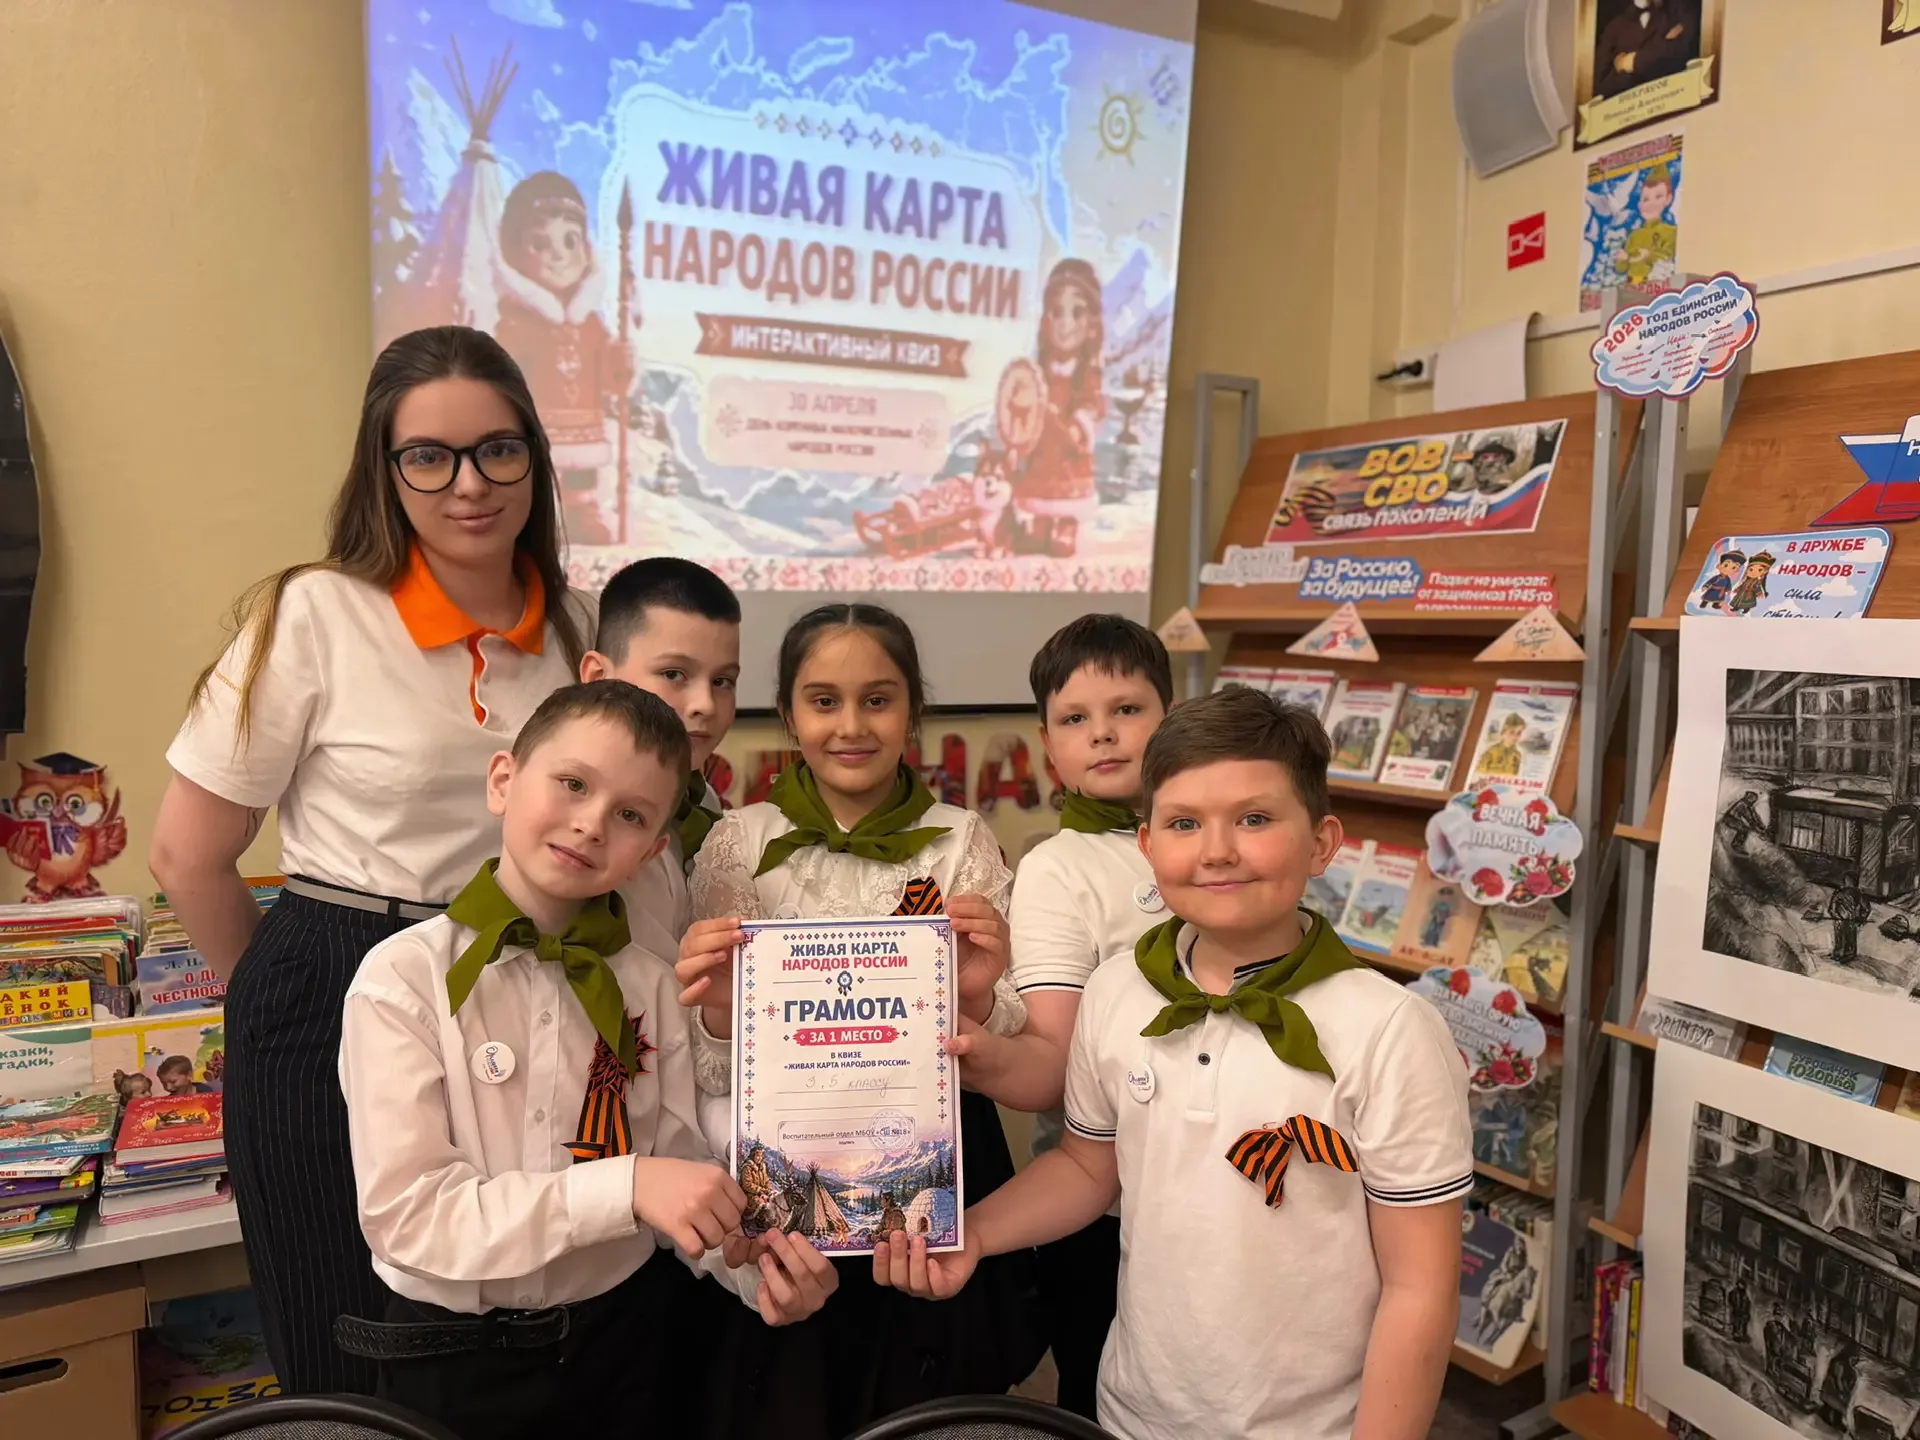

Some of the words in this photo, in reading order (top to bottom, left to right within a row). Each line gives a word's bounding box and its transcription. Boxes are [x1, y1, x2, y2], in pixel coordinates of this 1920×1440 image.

[657, 139, 846, 227] ЖИВАЯ
[863, 170, 1009, 249] КАРТА
[642, 220, 856, 306] НАРОДОВ
[869, 248, 1022, 320] РОССИИ
[1603, 313, 1645, 353] 2026
[1646, 310, 1669, 325] ГОД
[1671, 288, 1728, 318] ЕДИНСТВА
[1638, 317, 1691, 340] НАРОДОВ
[1693, 298, 1738, 324] РОССИИ
[731, 325, 892, 362] ИНТЕРАКТИВНЫЙ
[896, 341, 940, 367] КВИЗ
[1359, 441, 1446, 478] ВОВ
[1363, 471, 1448, 508] СВО
[1374, 502, 1487, 528] поколений
[1786, 542, 1796, 553] В
[1799, 538, 1866, 554] ДРУЖБЕ
[1309, 559, 1335, 578] За
[1336, 558, 1414, 580] Россию,
[1778, 564, 1853, 577] НАРОДОВ
[1300, 583, 1323, 596] за
[1324, 574, 1421, 600] будущее!
[1784, 588, 1822, 601] сила
[1480, 803, 1541, 831] ВЕЧНАЯ
[1472, 828, 1540, 856] ПАМЯТЬ
[790, 943, 847, 957] ЖИВАЯ
[851, 941, 900, 955] КАРТА
[782, 957, 850, 972] НАРОДОВ
[853, 955, 908, 969] РОССИИ
[784, 997, 908, 1023] ГРАМОТА
[809, 1031, 826, 1043] ЗА
[830, 1031, 836, 1042] 1
[841, 1029, 883, 1042] МЕСТО
[838, 1051, 862, 1059] КВИЗЕ
[841, 1060, 877, 1069] НАРОДОВ
[782, 1130, 835, 1141] Воспитательный
[855, 1129, 875, 1139] МБОУ
